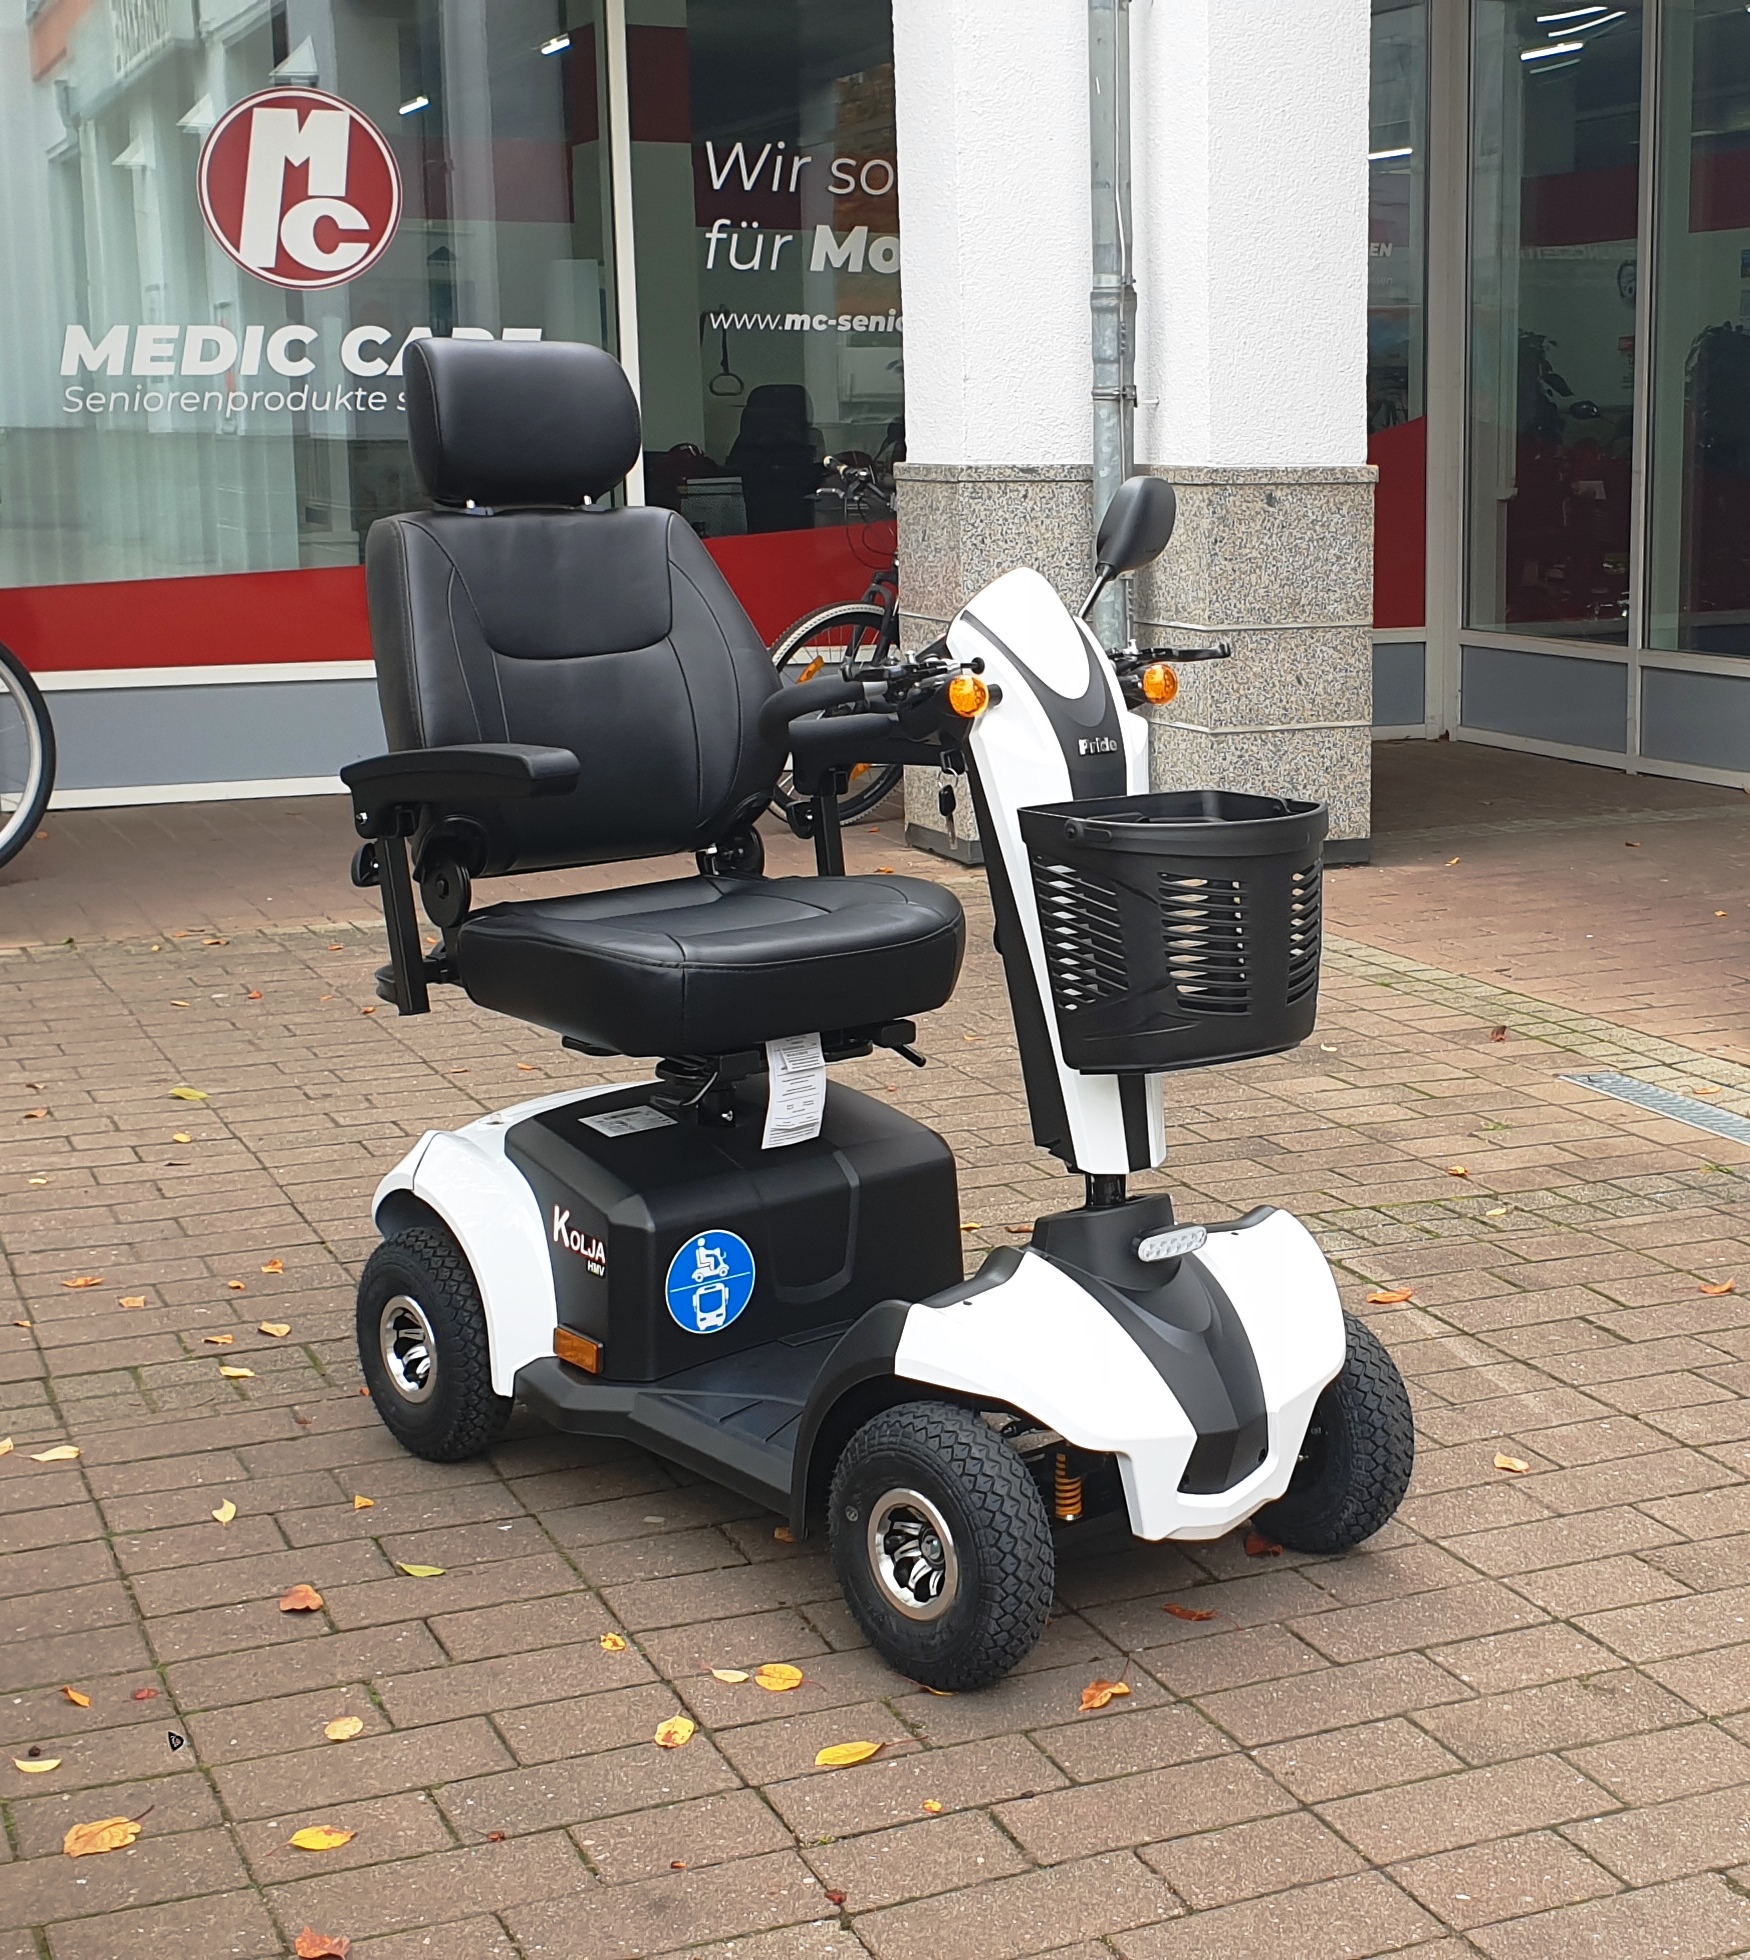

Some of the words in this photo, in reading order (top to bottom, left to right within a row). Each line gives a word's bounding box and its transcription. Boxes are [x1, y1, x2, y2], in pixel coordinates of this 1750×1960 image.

[240, 107, 371, 271] MC
[705, 140, 812, 193] Wir
[827, 158, 895, 196] so
[704, 218, 793, 271] für
[810, 224, 901, 274] Mo
[60, 324, 319, 377] MEDIC
[341, 325, 542, 377] CA
[62, 384, 387, 418] Seniorenprodukte
[1078, 737, 1118, 756] Pride
[552, 1204, 606, 1264] KOLJA
[587, 1260, 605, 1277] HMV
